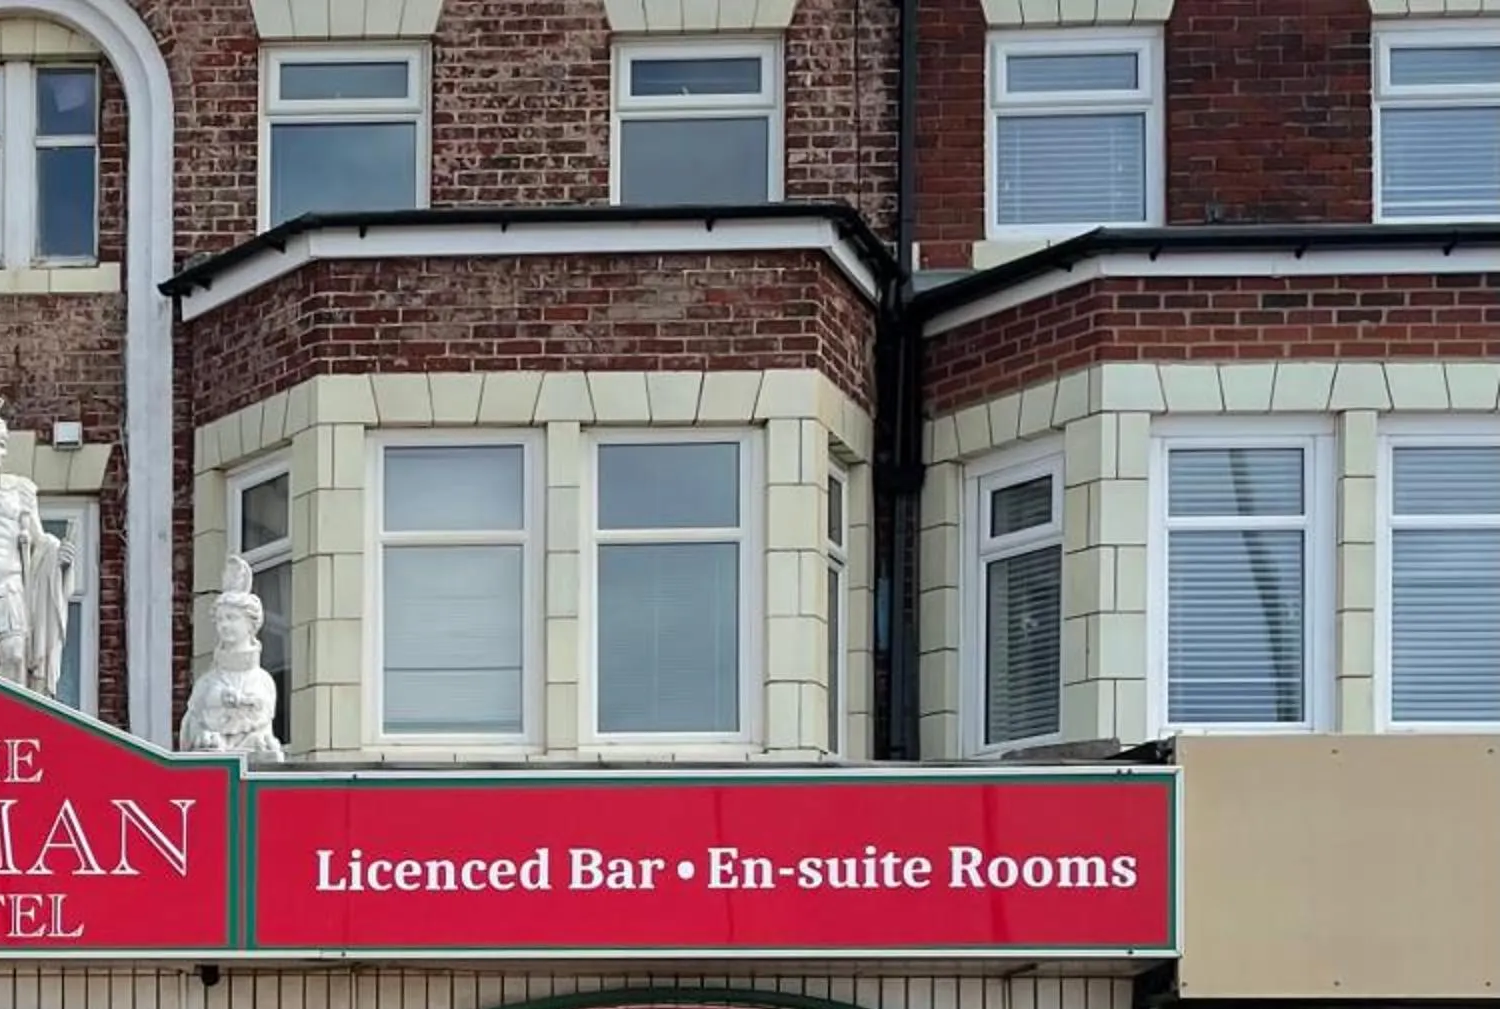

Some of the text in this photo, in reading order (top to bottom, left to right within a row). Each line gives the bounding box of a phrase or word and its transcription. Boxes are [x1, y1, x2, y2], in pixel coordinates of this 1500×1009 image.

[315, 845, 1138, 891] Licenced Bar En-suite Rooms
